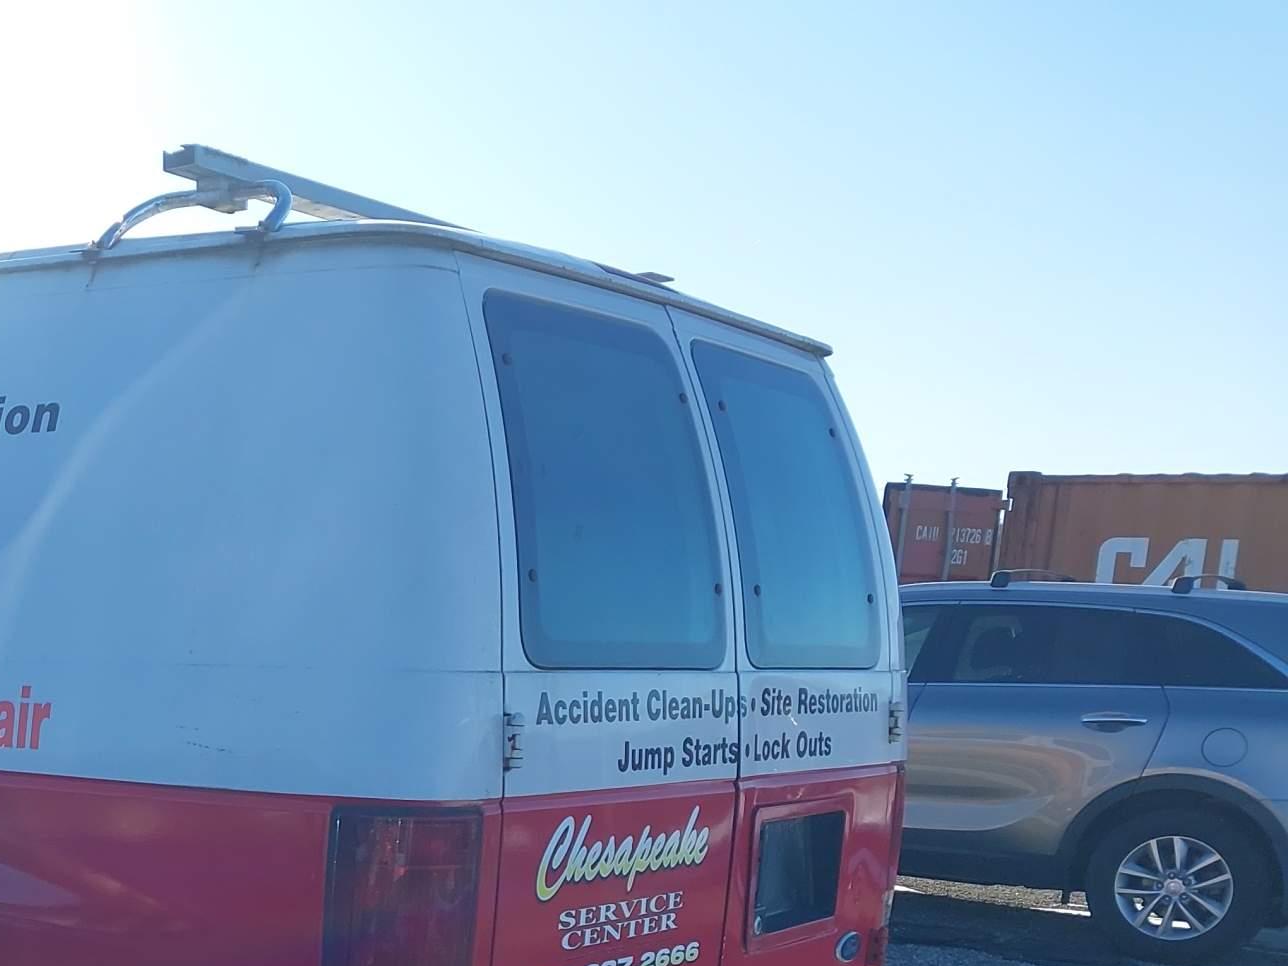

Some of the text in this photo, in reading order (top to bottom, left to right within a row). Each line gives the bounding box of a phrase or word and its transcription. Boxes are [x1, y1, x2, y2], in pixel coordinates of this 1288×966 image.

[535, 687, 879, 726] Accident Clean-Ups Site Restoration
[617, 730, 832, 776] Jump Starts Lock Outs
[536, 805, 710, 901] Chesapeake
[558, 891, 684, 931] SERVICE
[561, 912, 678, 951] CENTER
